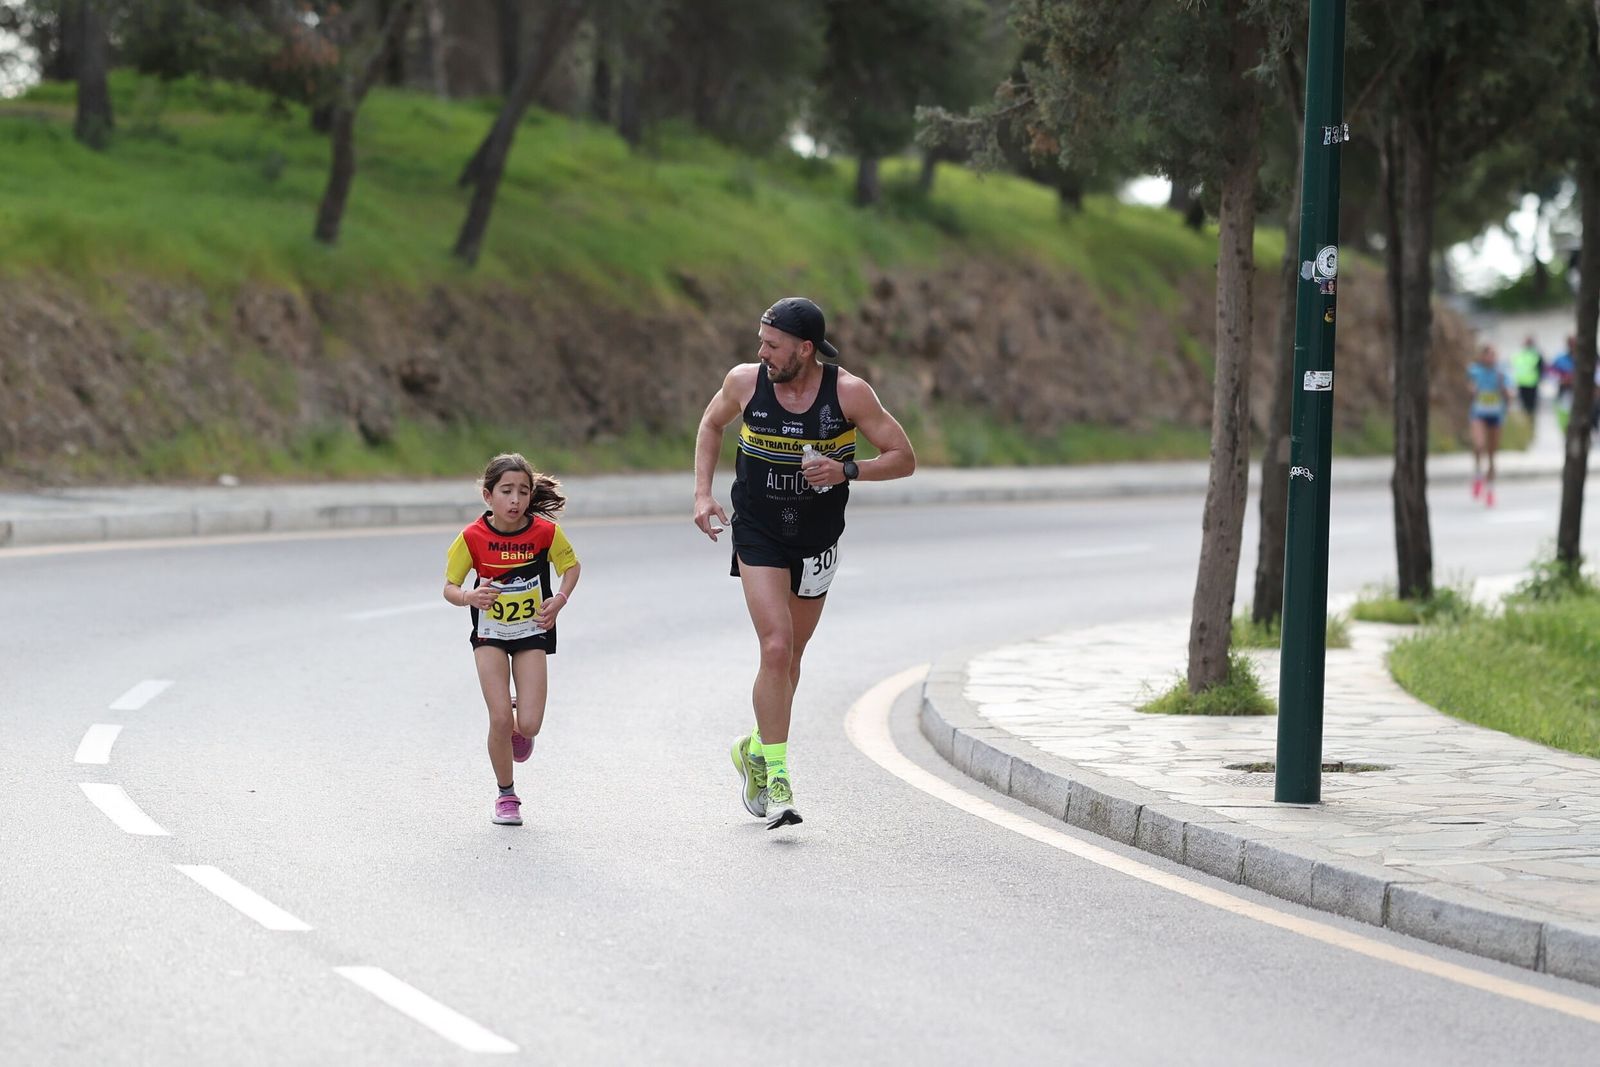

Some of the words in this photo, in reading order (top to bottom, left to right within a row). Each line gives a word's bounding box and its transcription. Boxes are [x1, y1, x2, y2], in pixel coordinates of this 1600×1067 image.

[748, 435, 764, 446] CLUB
[488, 541, 535, 553] Málaga
[501, 551, 534, 560] Bahía
[491, 598, 536, 622] 923
